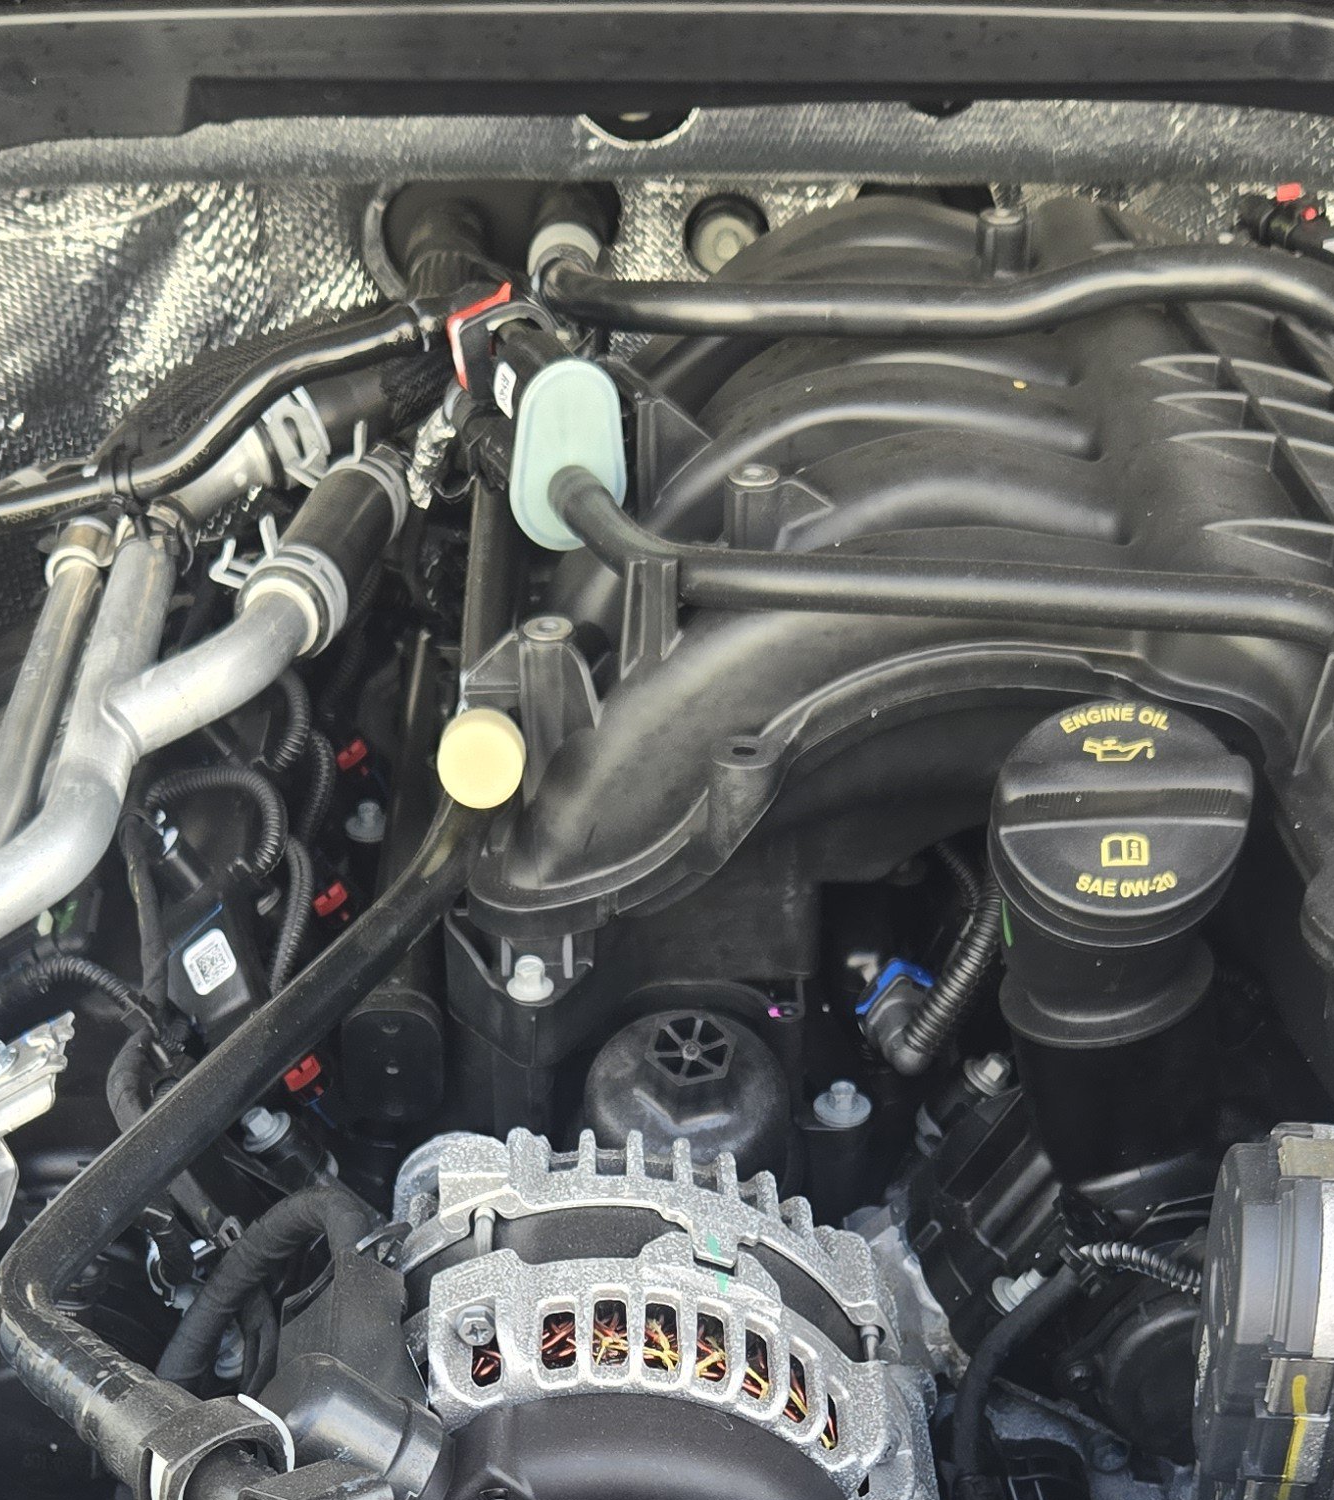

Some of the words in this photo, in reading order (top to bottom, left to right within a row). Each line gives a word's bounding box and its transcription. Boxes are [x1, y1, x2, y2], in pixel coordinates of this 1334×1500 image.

[1060, 705, 1135, 735] ENGINE
[1139, 707, 1171, 732] OIL
[1075, 872, 1117, 899] SAE
[1120, 869, 1178, 898] 0W-20
